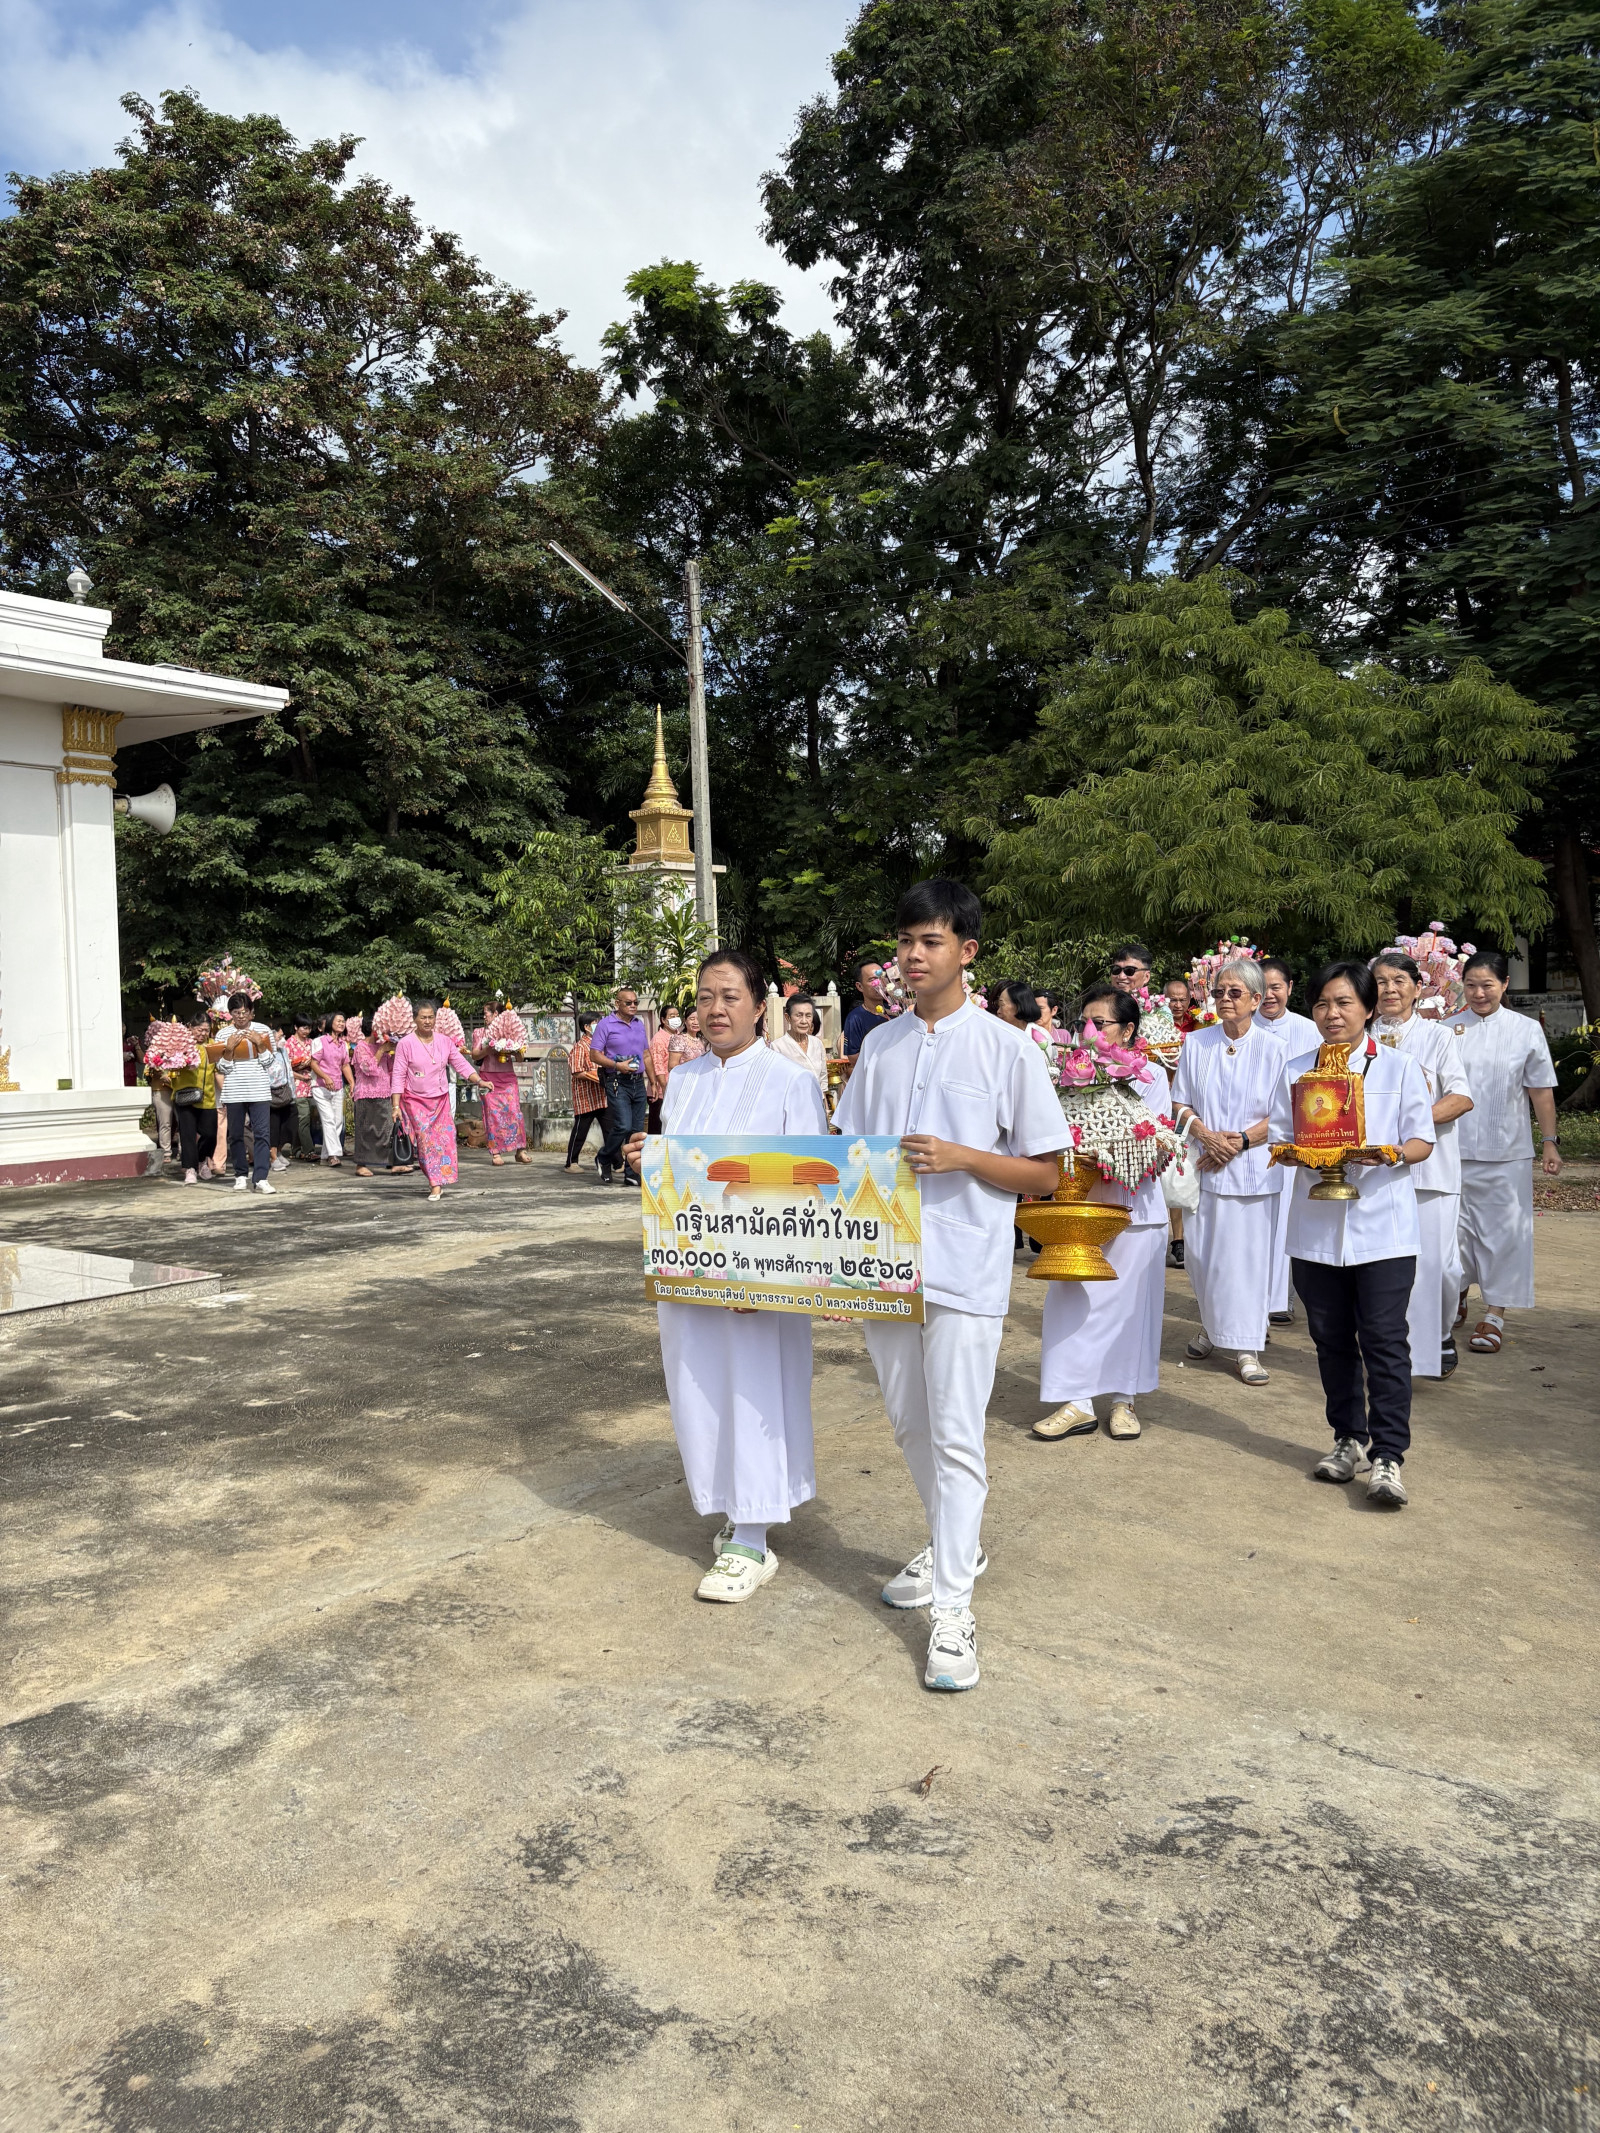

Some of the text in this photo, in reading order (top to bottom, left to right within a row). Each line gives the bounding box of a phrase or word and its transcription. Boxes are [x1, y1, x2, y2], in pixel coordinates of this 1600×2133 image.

[675, 1199, 878, 1241] กฐินสามัคคีทั่วไทย
[651, 1248, 913, 1280] ๓๐,๐๐๐ วัด พุทธศักราช ๒๕๖๘
[655, 1282, 911, 1314] โดย คณะศิษยานุศิษย์ บูชาธรรม ๘๑ ปี หลวงพ่อธัมมชโย
